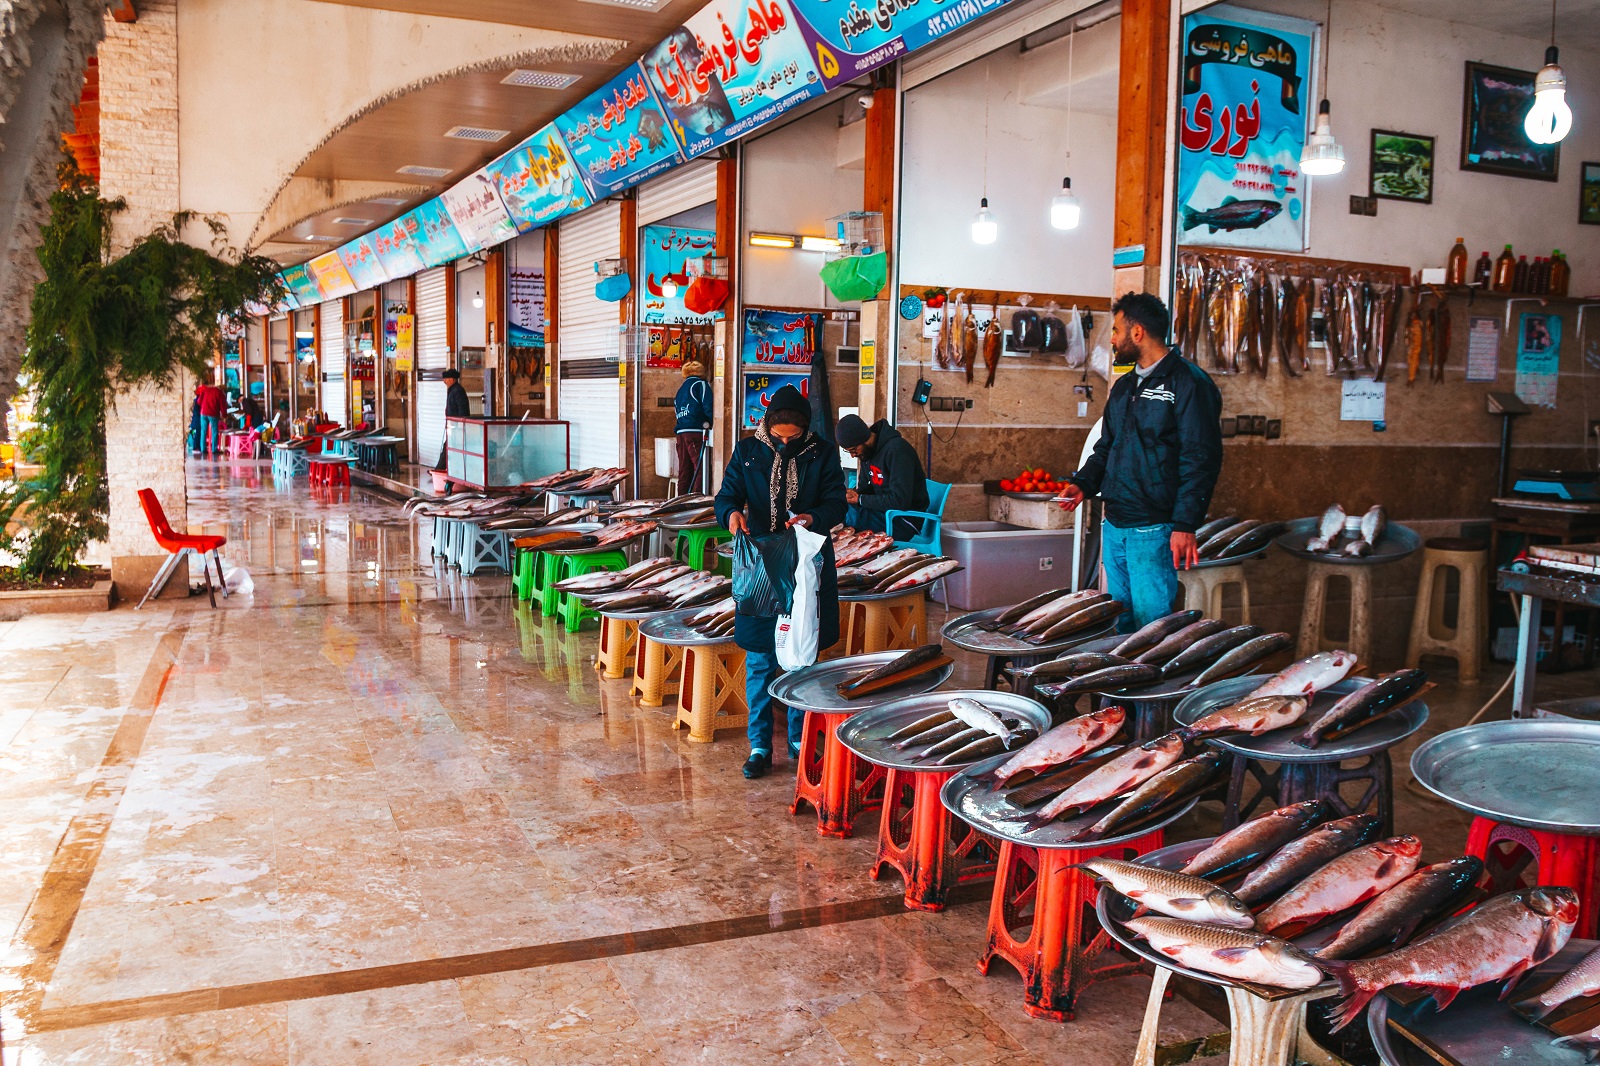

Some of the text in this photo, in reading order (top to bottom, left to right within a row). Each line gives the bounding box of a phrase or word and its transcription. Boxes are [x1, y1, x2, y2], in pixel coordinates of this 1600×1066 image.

[839, 3, 873, 50] مقدم
[655, 0, 787, 106] ماهی فروشی آریا
[816, 42, 840, 80] ۵
[1191, 30, 1292, 67] ماهی فروشی
[756, 80, 767, 96] های
[768, 70, 782, 90] ماهی
[783, 60, 799, 85] انواع
[623, 73, 648, 109] امانت
[601, 88, 626, 130] فروشی
[1181, 79, 1261, 157] نوری
[627, 133, 642, 161] ماهی
[673, 118, 687, 147] ۶
[527, 147, 550, 188] سرای
[547, 134, 567, 179] ماهی
[608, 139, 627, 170] فروشی
[662, 229, 690, 252] فروشی
[646, 301, 665, 309] فروشی
[755, 338, 786, 362] برون
[749, 377, 768, 391] تازه
